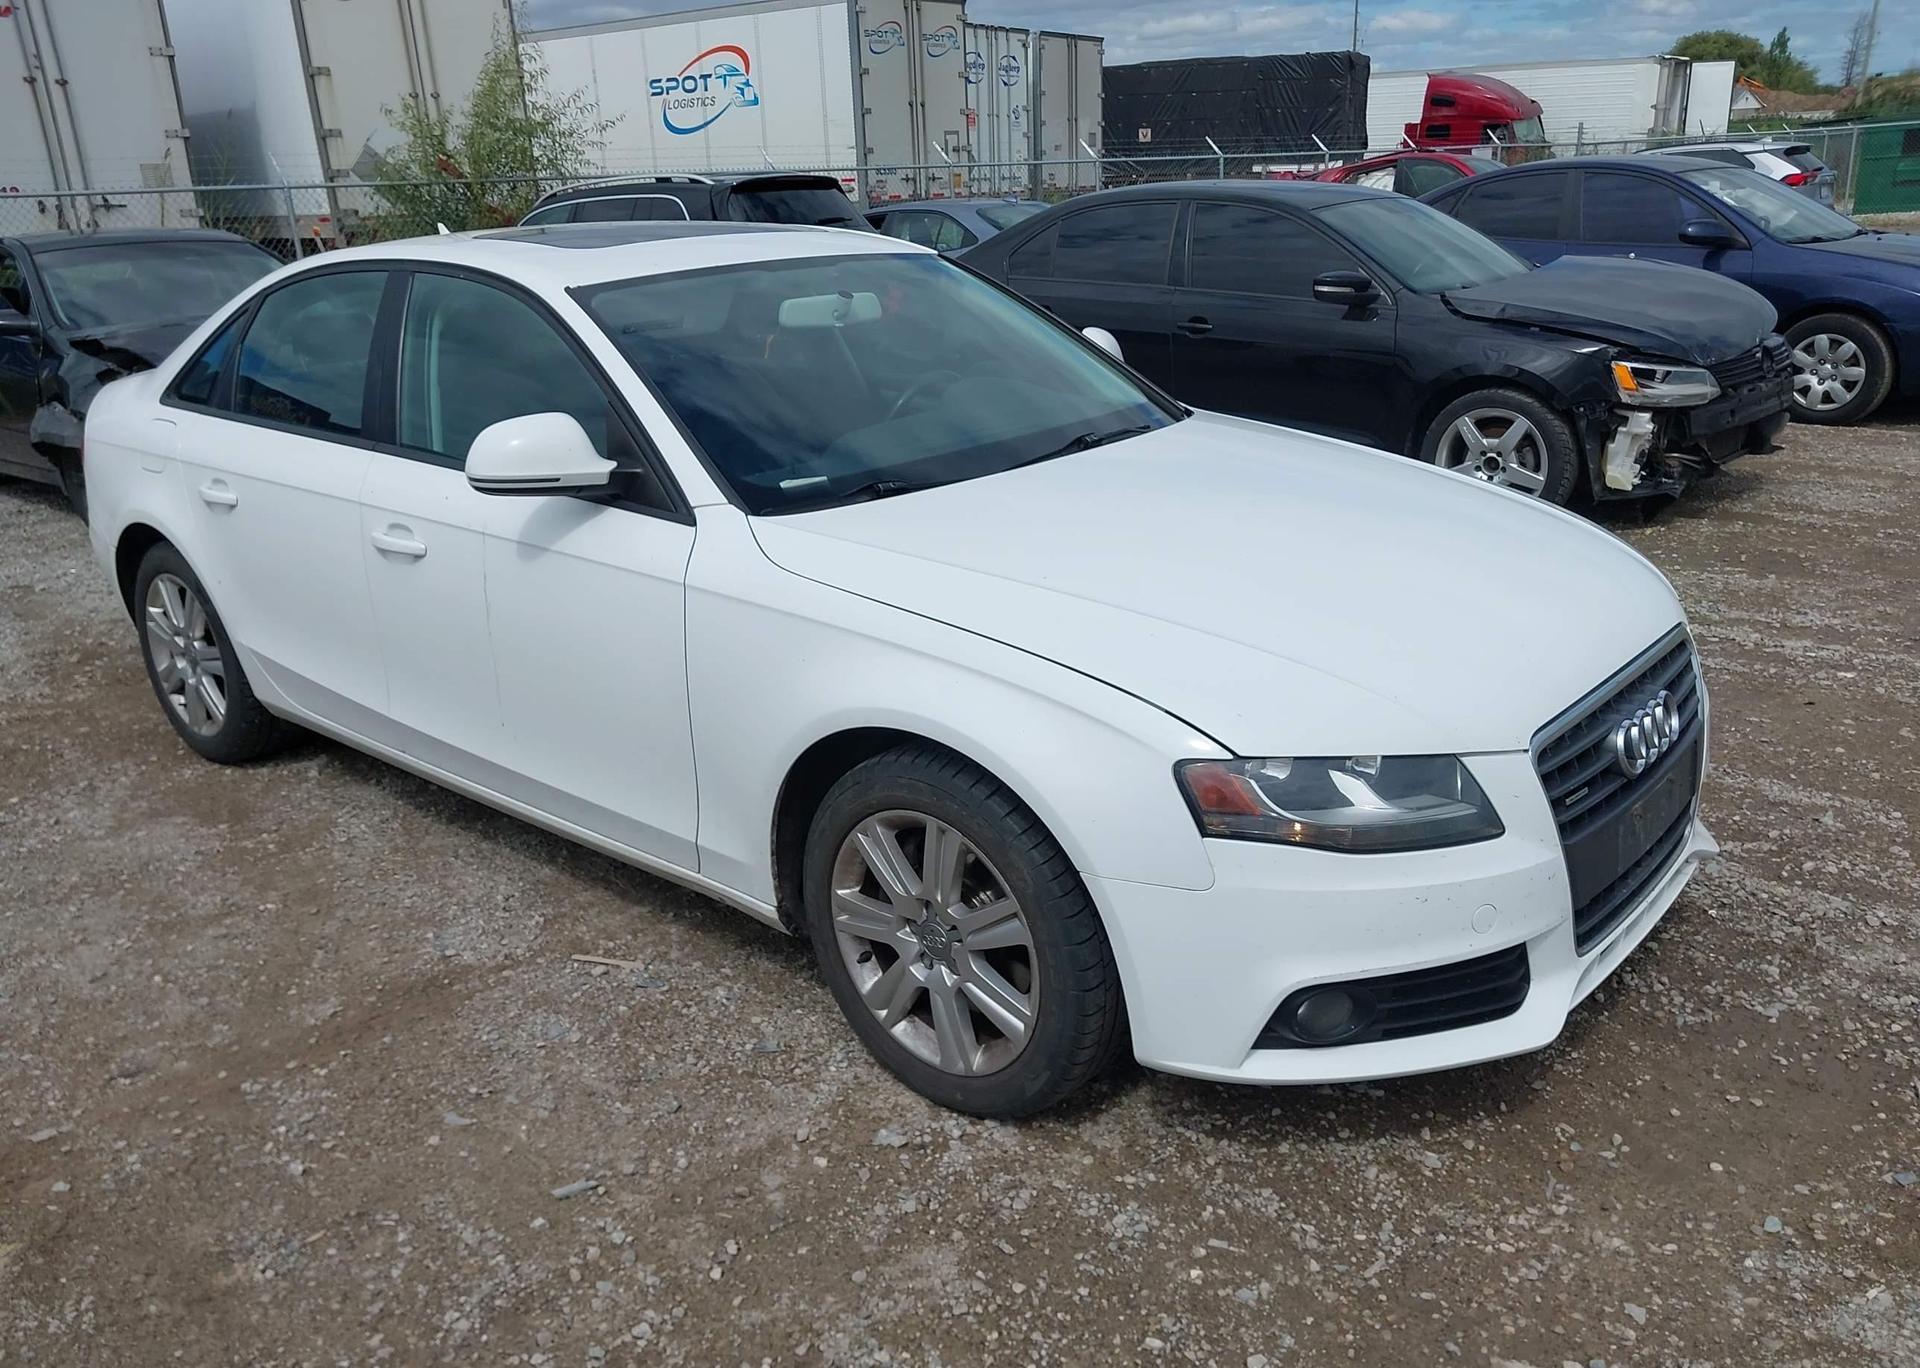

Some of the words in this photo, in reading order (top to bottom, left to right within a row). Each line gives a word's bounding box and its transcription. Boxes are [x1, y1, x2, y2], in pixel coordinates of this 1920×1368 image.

[863, 29, 888, 38] SPOT
[922, 33, 945, 42] SPOT
[649, 73, 713, 97] SPOT
[667, 95, 717, 110] LOGISTICS
